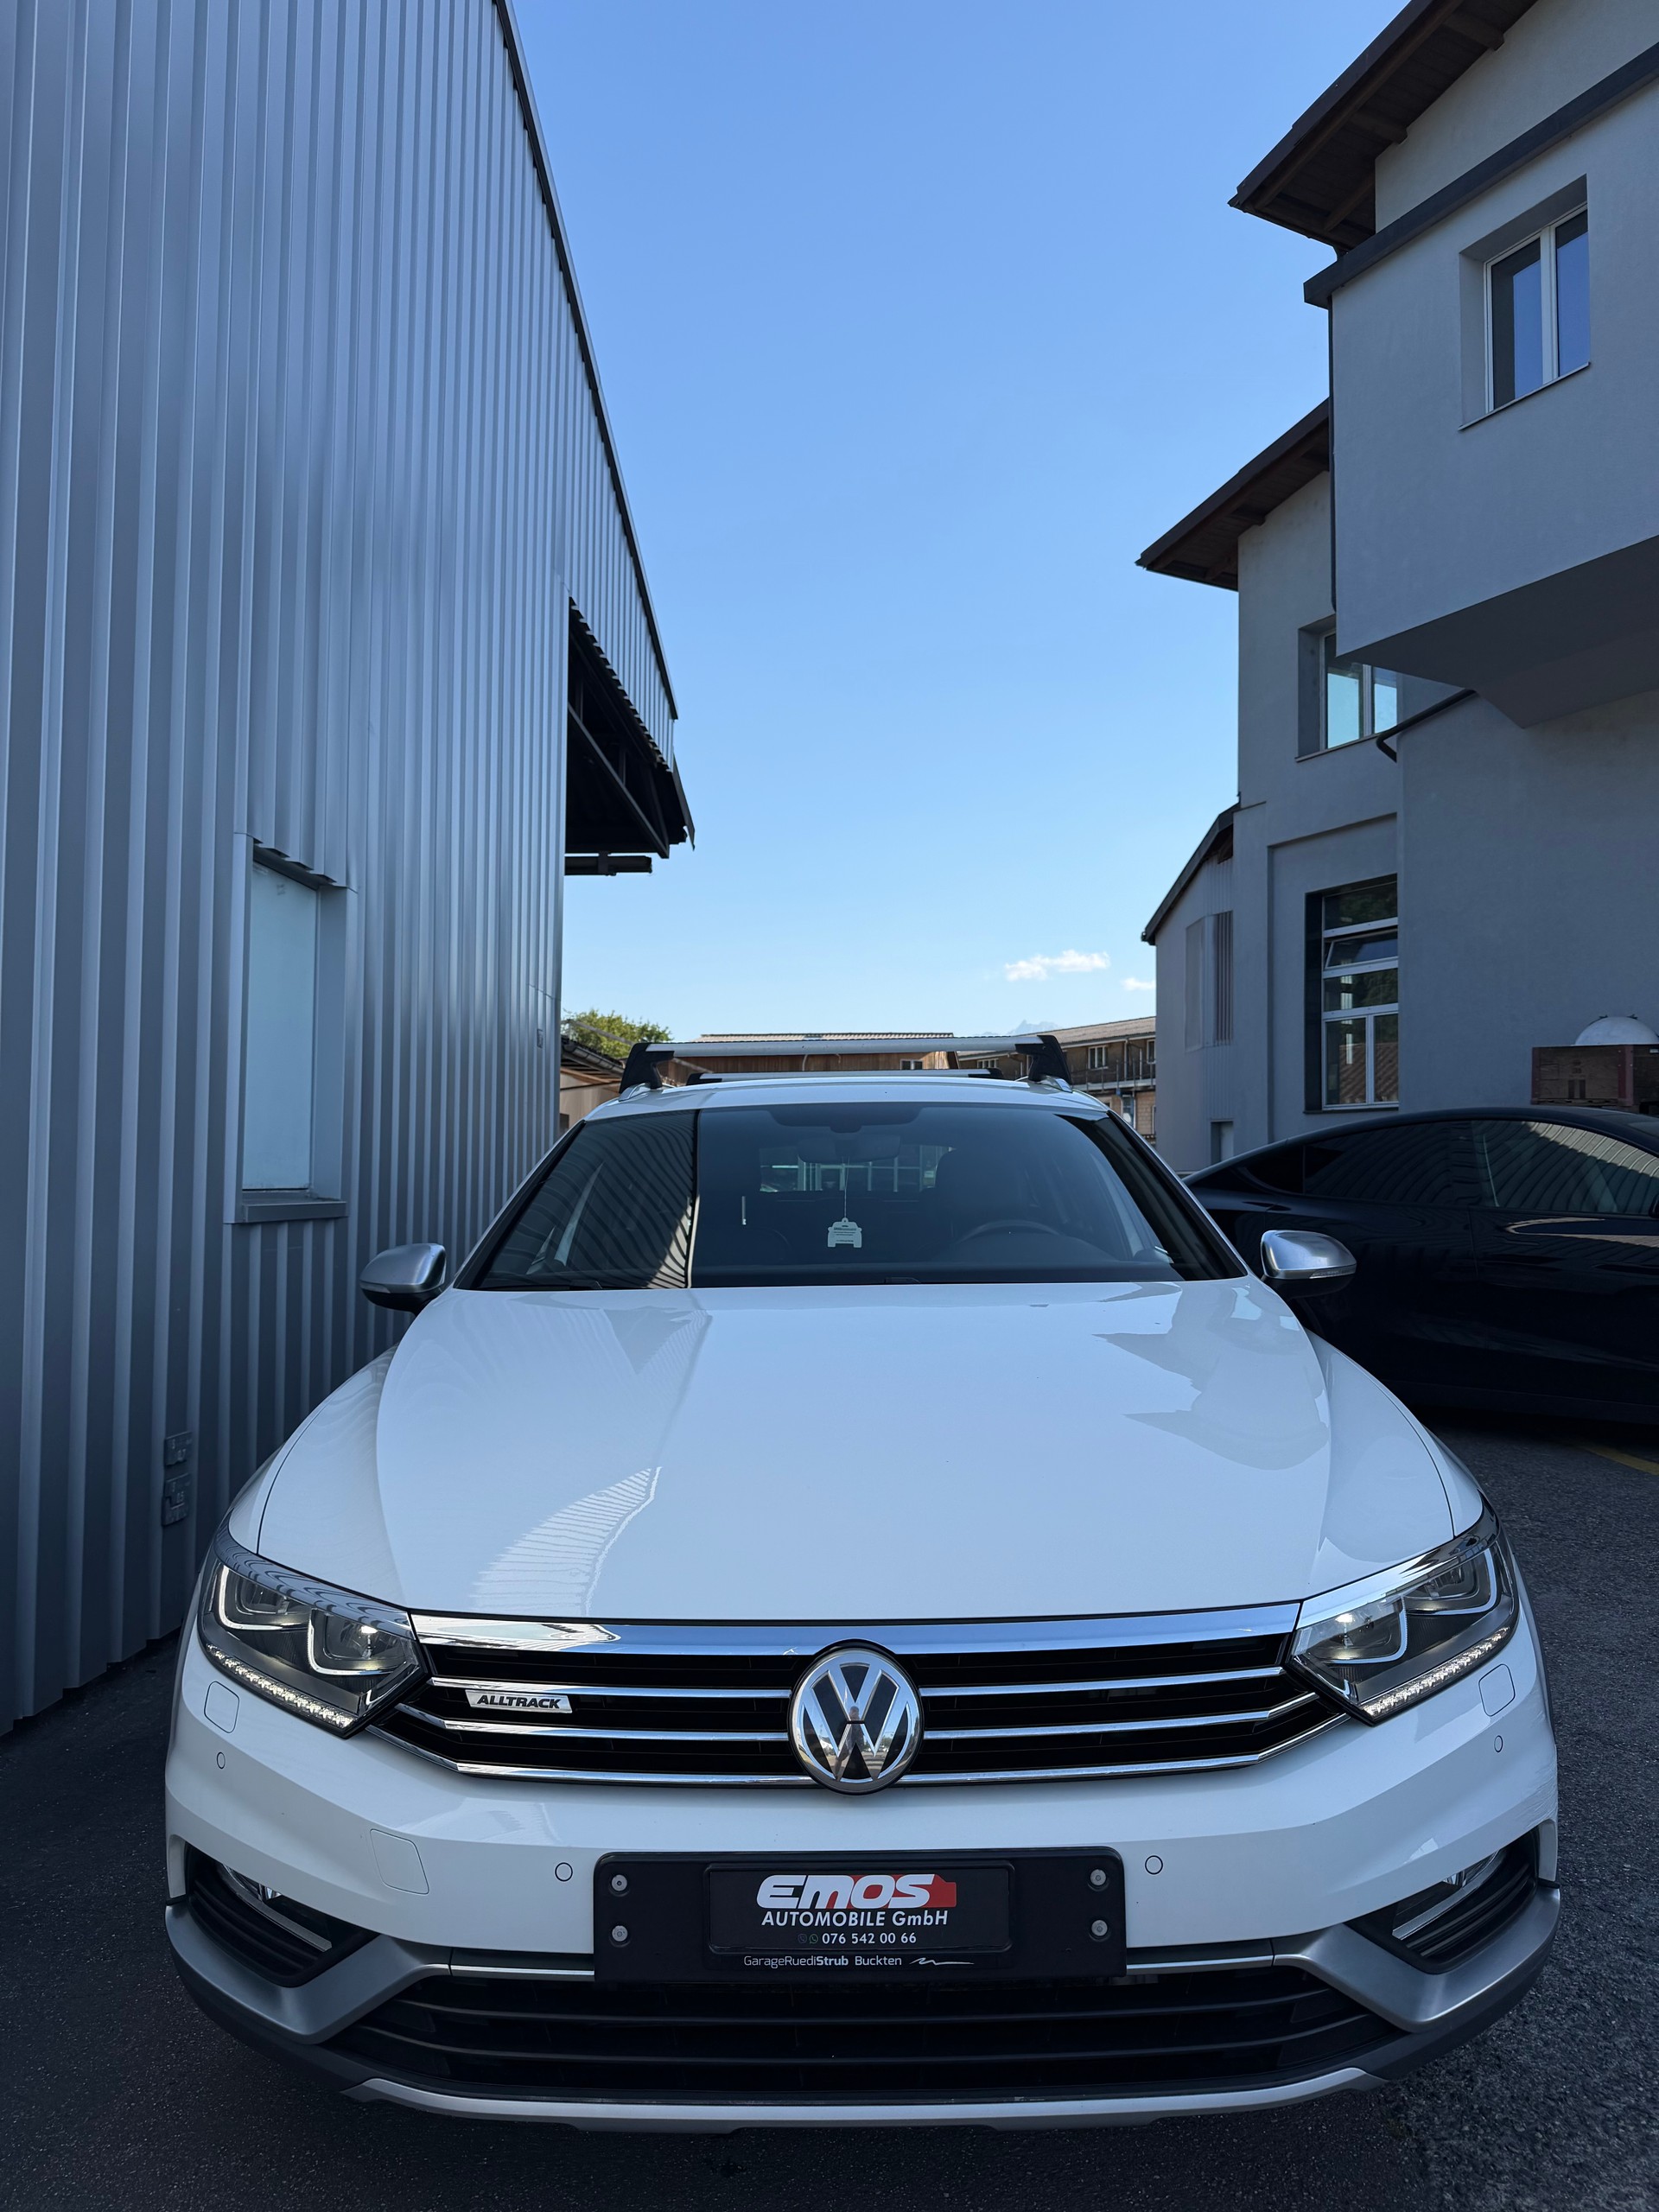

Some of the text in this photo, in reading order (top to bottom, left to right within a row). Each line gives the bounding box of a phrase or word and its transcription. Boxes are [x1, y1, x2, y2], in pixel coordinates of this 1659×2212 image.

[477, 1694, 562, 1709] ALLTRACK
[798, 1650, 916, 1789] VW
[756, 1873, 936, 1910] EMOS
[761, 1910, 949, 1927] AUTOMOBILE GmbH
[822, 1932, 917, 1944] 076 542 00 66
[743, 1955, 902, 1969] GarageRuediStrub Buckten
